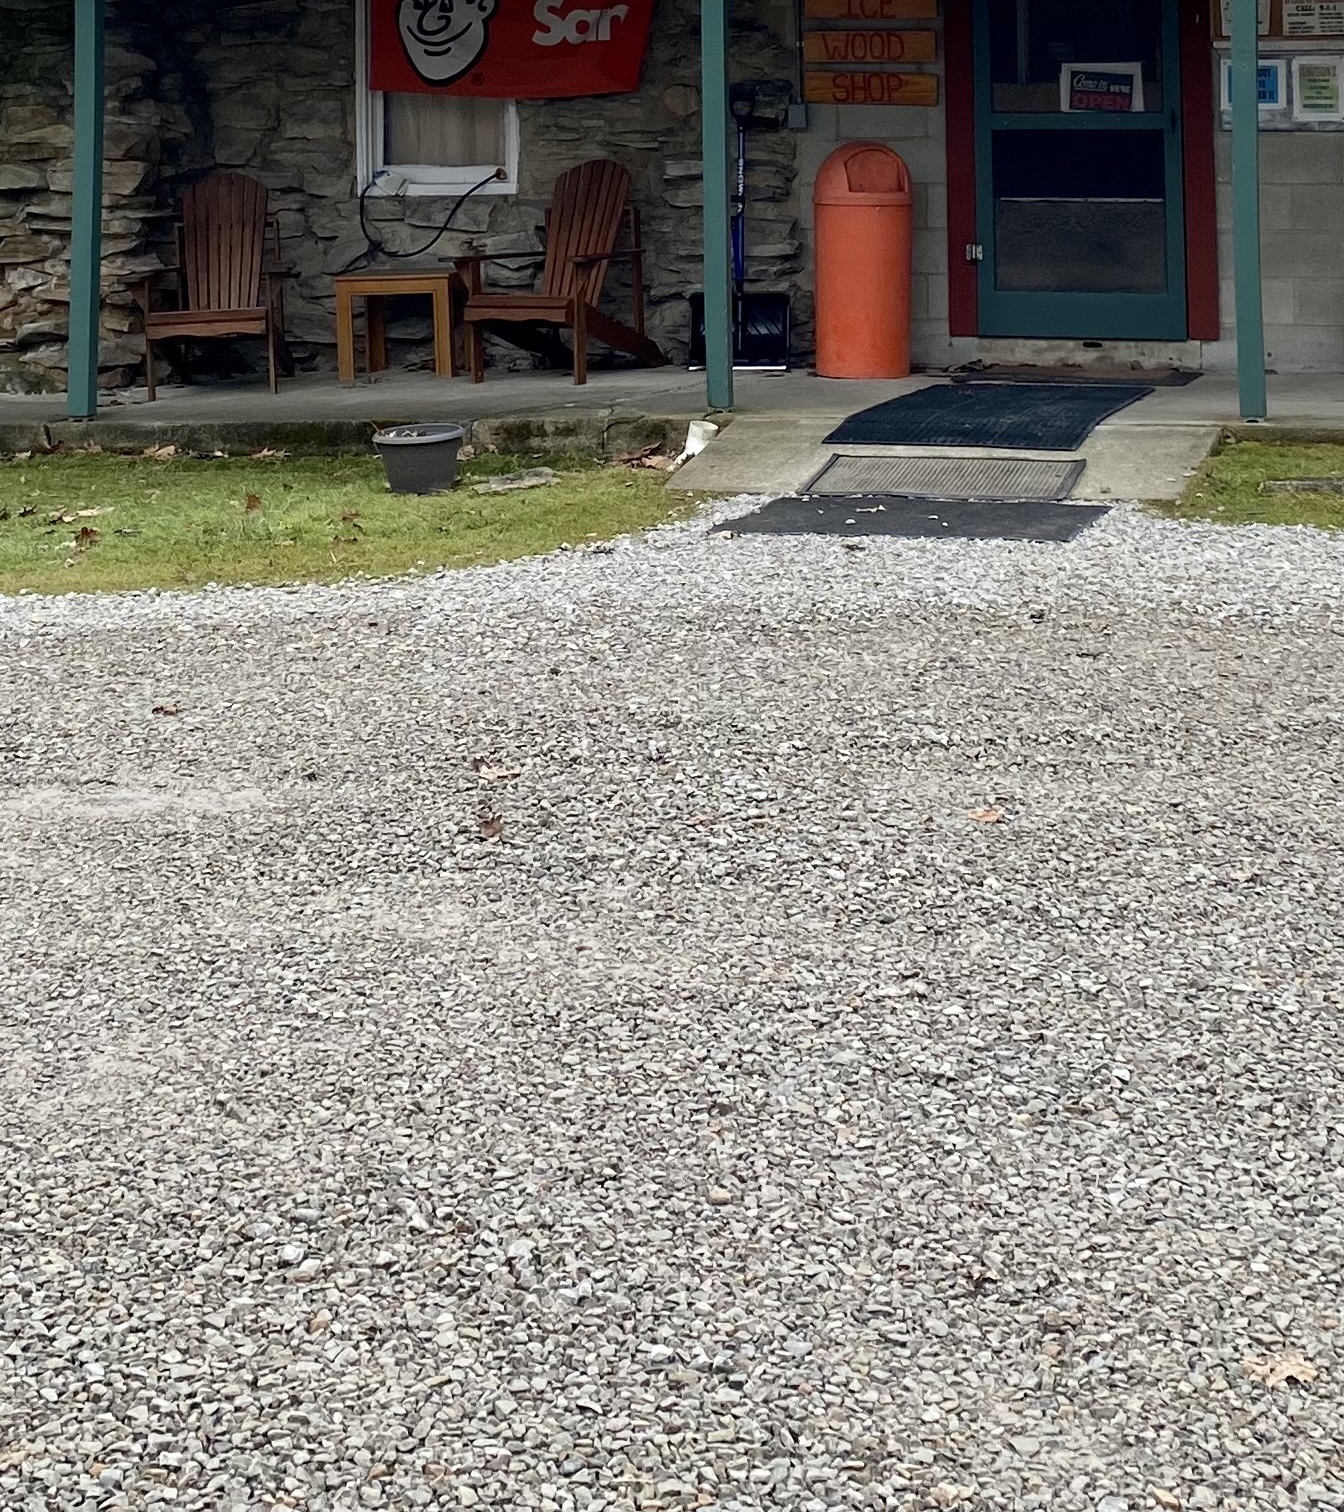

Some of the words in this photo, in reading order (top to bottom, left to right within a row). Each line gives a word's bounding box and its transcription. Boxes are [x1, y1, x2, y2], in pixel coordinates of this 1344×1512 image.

[821, 33, 905, 61] WOOD
[832, 73, 903, 102] SHOP
[1073, 93, 1129, 109] OPEN
